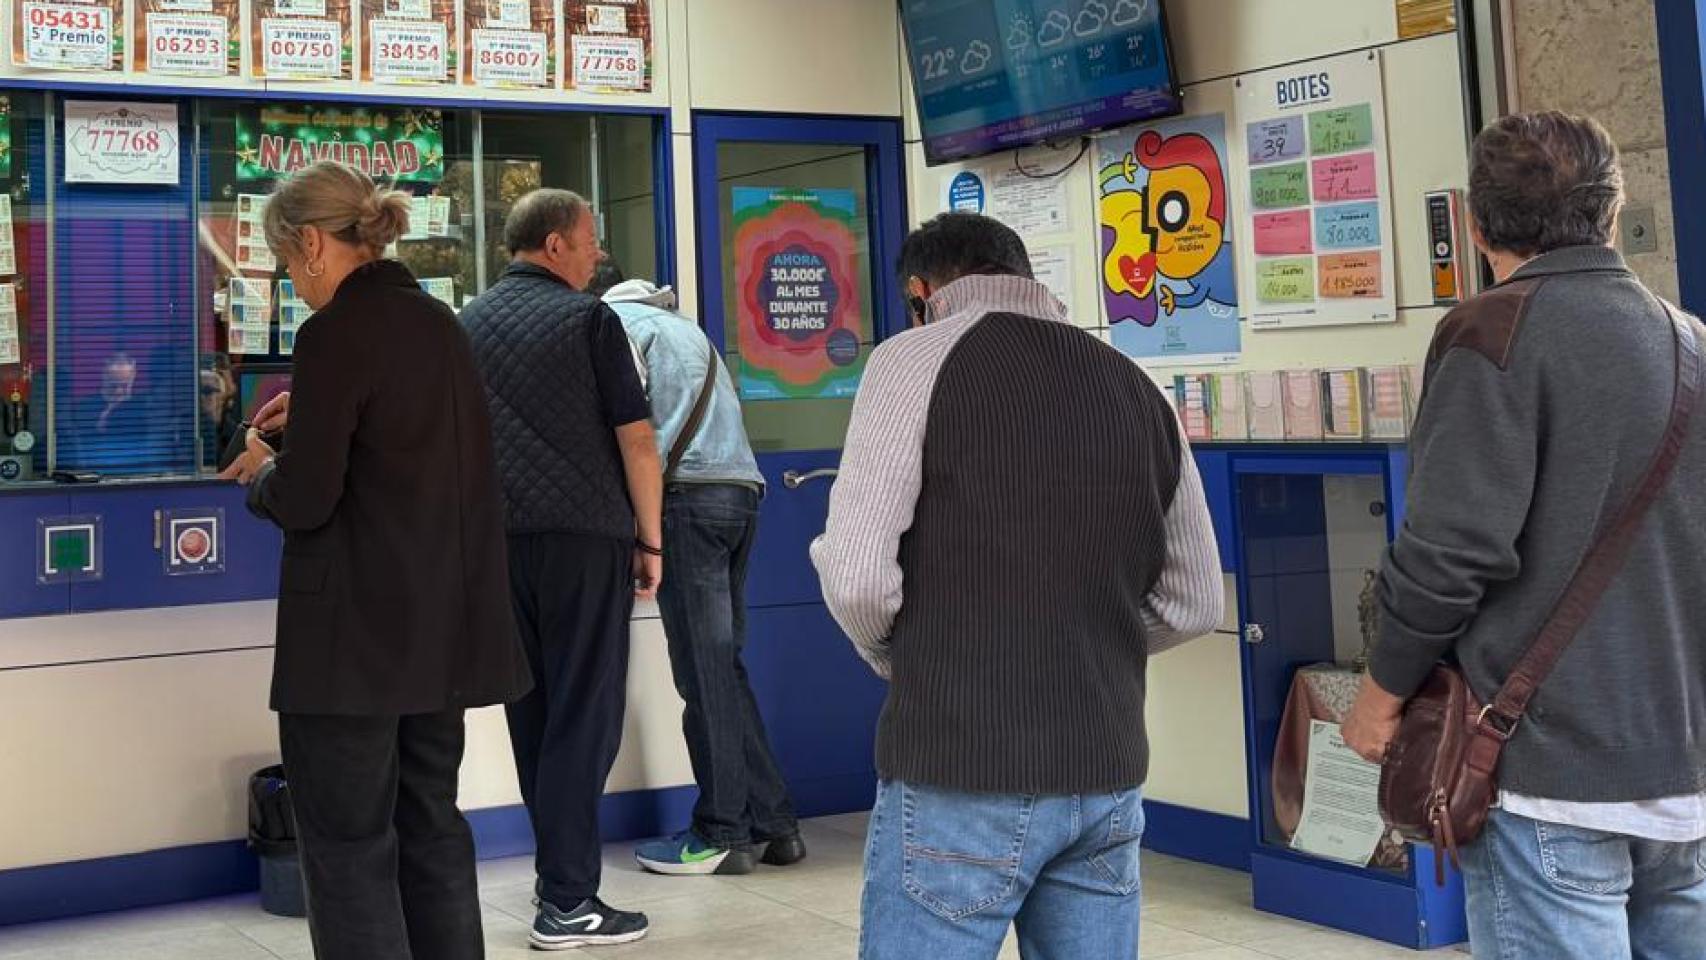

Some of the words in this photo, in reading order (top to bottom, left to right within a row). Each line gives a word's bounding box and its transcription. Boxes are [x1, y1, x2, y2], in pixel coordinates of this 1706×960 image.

[30, 9, 104, 29] 05431
[49, 28, 106, 45] Premio
[177, 28, 212, 37] PREMIO
[287, 31, 332, 41] PREMIO
[156, 36, 219, 53] 06293
[271, 41, 333, 57] 00750
[379, 43, 440, 61] 38454
[480, 50, 541, 67] 86007
[580, 56, 637, 72] 77768
[921, 47, 956, 80] 22°
[1276, 72, 1330, 105] BOTES
[88, 129, 160, 153] 77768
[1263, 137, 1286, 159] 39
[774, 255, 820, 266] AHORA
[770, 268, 827, 282] 30.000€
[776, 284, 795, 298] AL
[795, 285, 820, 298] MES
[768, 300, 829, 314] DURANTE
[773, 316, 791, 330] 30
[791, 314, 825, 329] AÑOS
